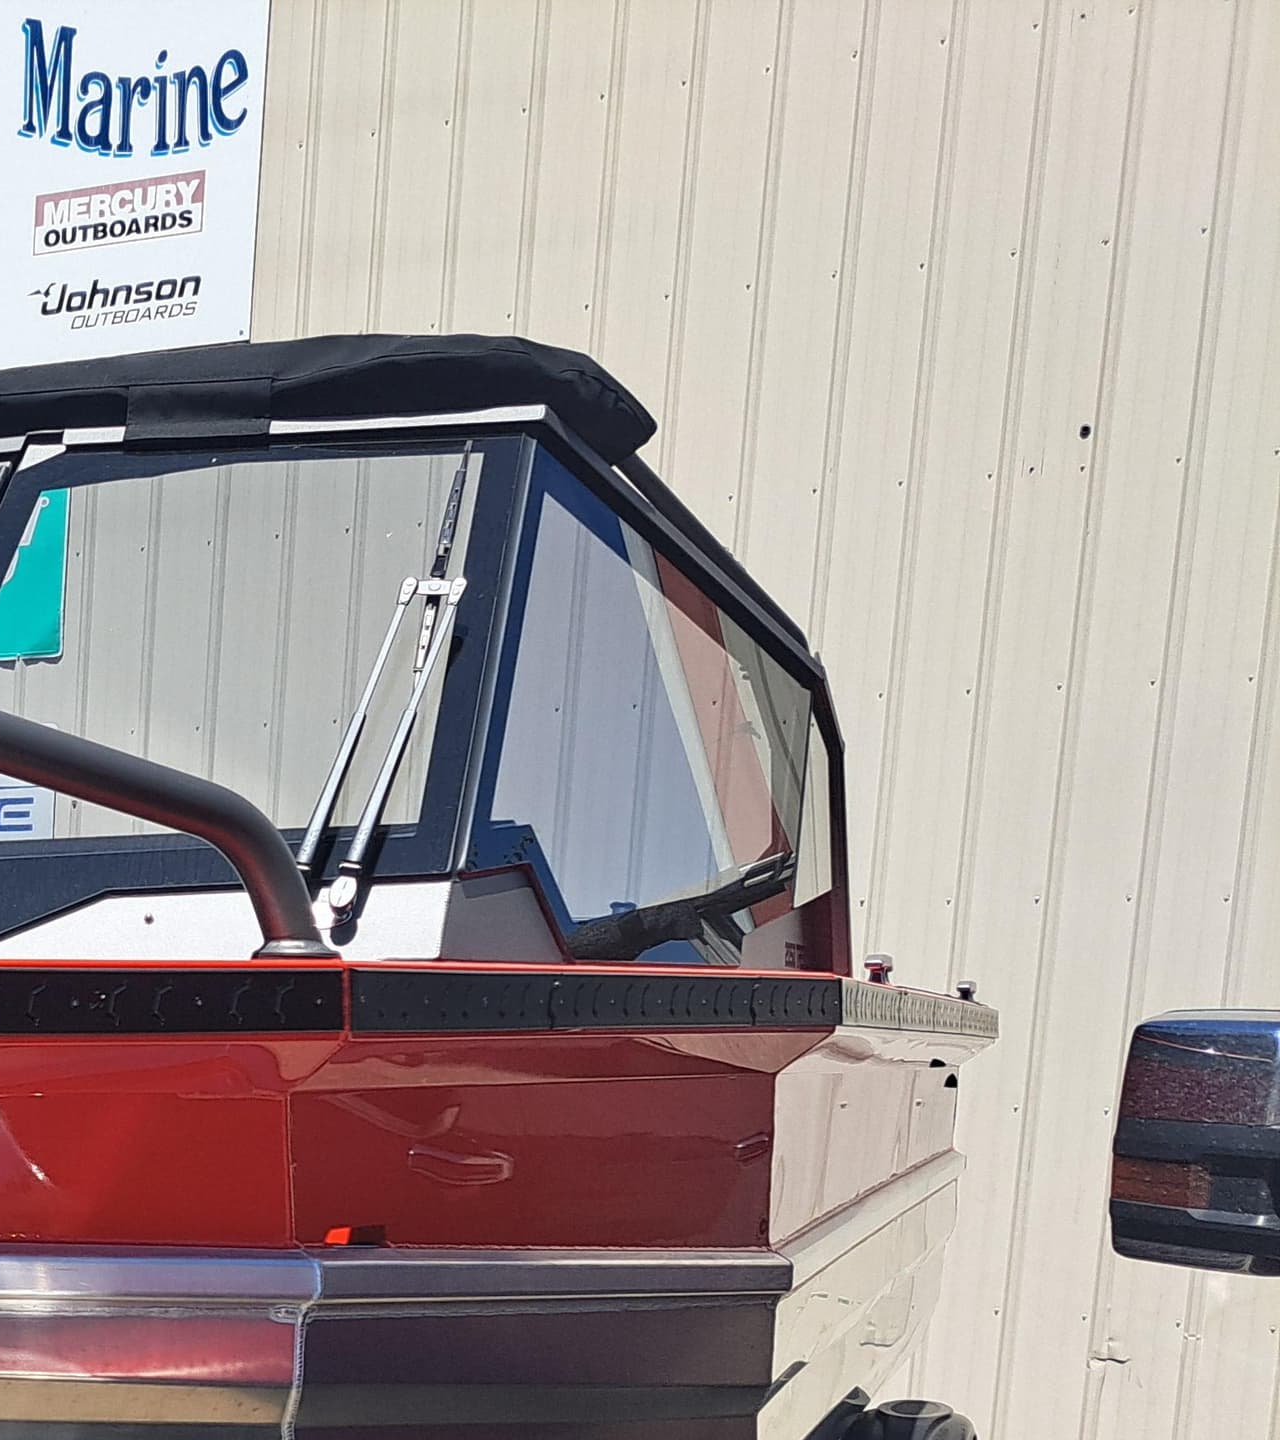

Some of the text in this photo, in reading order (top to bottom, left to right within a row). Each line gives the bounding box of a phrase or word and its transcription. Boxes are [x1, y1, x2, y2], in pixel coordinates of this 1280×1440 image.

[17, 17, 250, 158] Marine
[42, 179, 201, 225] MERCURY
[44, 209, 193, 248] OUTBOARDS
[40, 275, 202, 316] Johnson
[70, 301, 198, 330] OUTBOARDS
